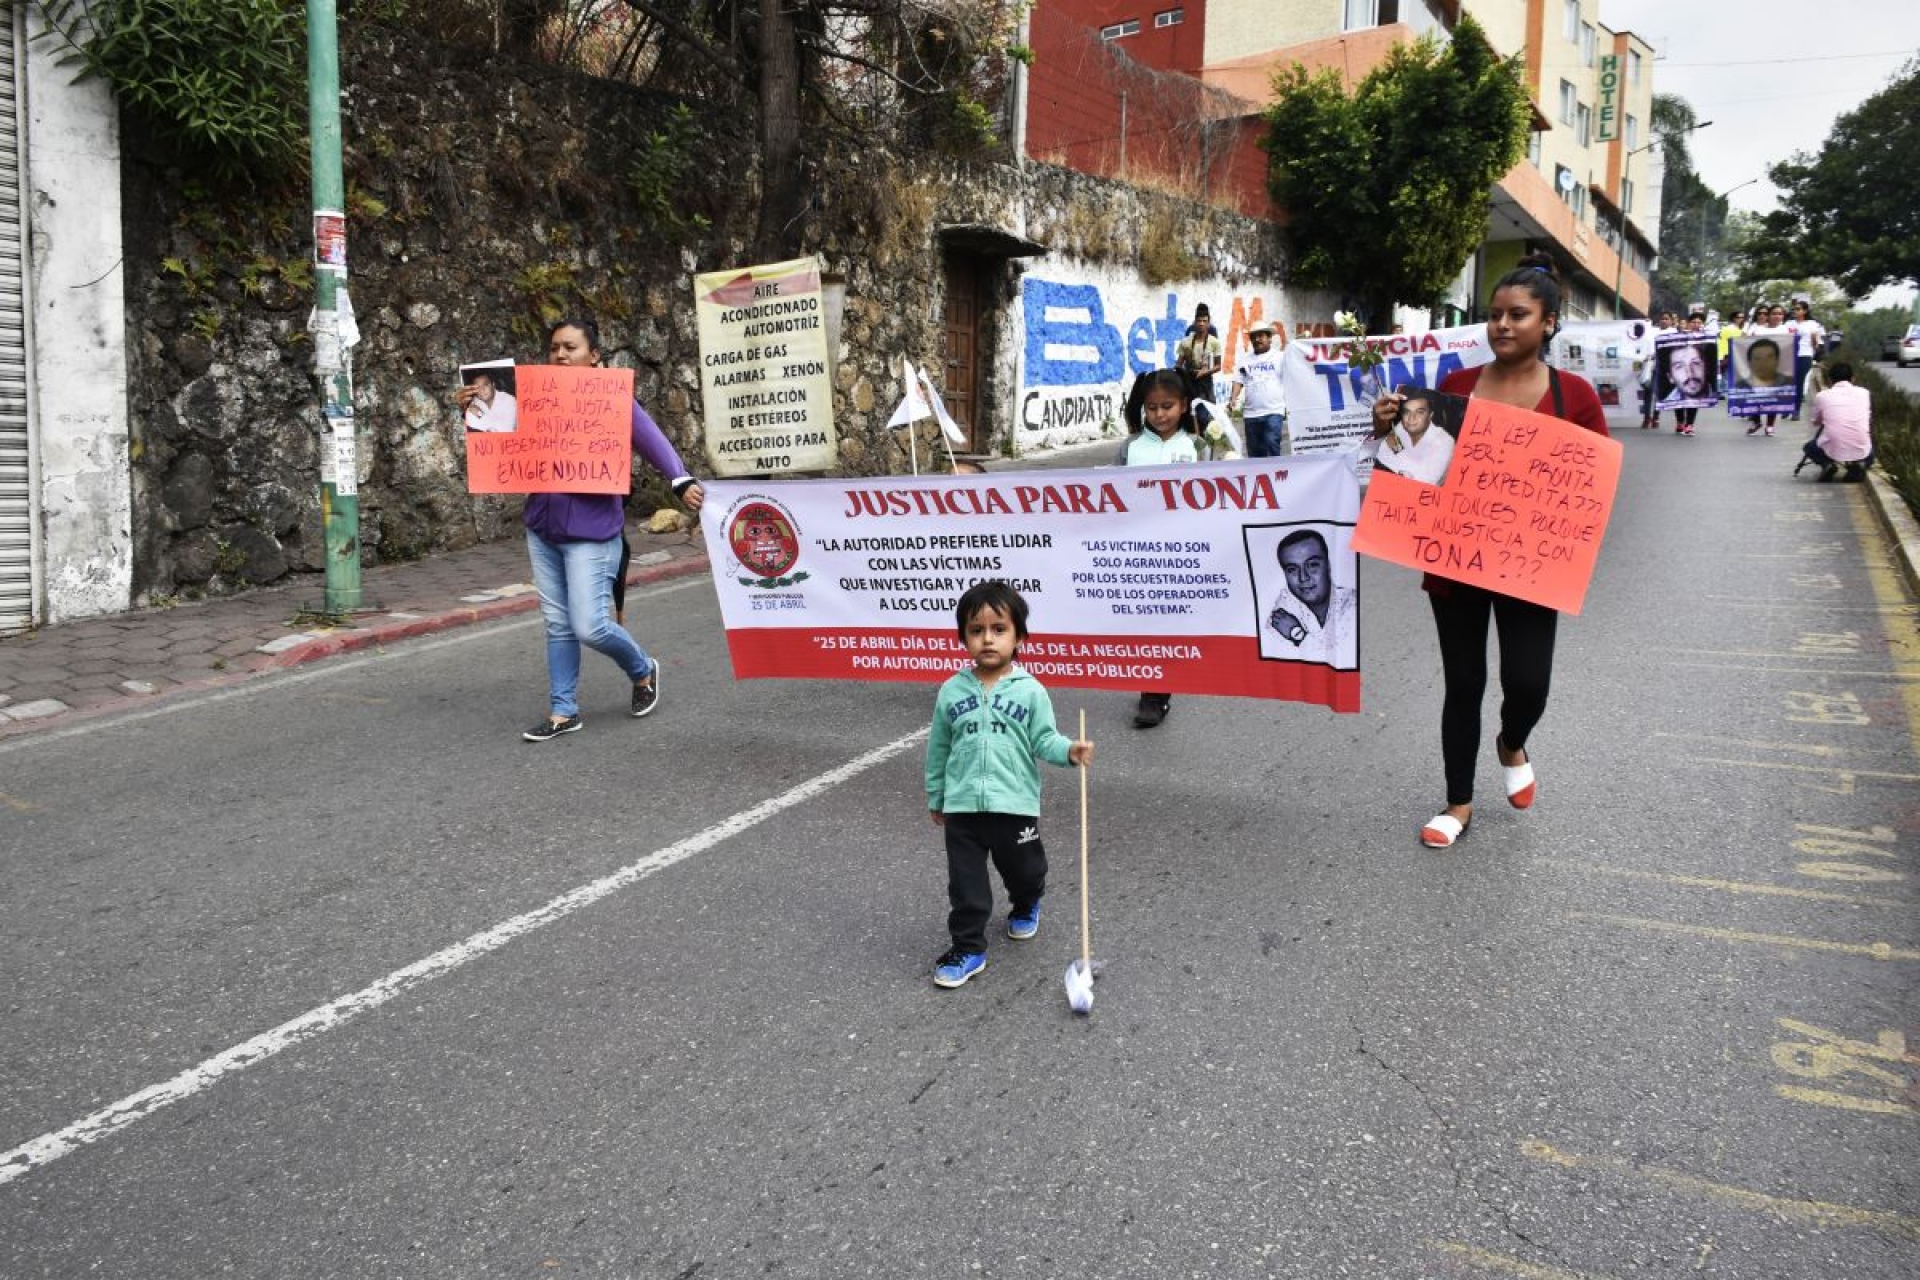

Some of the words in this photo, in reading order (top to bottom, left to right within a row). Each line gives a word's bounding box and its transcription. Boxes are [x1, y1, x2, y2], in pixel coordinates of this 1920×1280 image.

[1600, 55, 1616, 138] HOTEL
[753, 283, 780, 299] AIRE
[721, 298, 818, 324] ACONDICIONADO
[1023, 276, 1188, 388] Bet
[1447, 339, 1479, 350] PARA
[705, 354, 745, 367] CARGA
[746, 348, 761, 361] DE
[764, 344, 788, 358] GAS
[713, 367, 766, 387] ALARMAS
[782, 360, 825, 379] XENÓN
[542, 375, 558, 392] LA
[571, 375, 628, 395] JUSTICIA
[728, 386, 807, 410] INSTALACIÓN
[1023, 391, 1112, 431] CANDIDATO
[730, 416, 745, 429] DE
[474, 440, 493, 456] NO
[718, 435, 791, 454] ACCESORIOS
[794, 431, 828, 447] PARA
[1470, 414, 1493, 437] LA
[1503, 424, 1540, 448] LEY
[1549, 438, 1599, 468] DEBE
[756, 455, 791, 470] AUTO
[1458, 466, 1471, 487] Y
[1528, 458, 1596, 489] PRONTA
[844, 486, 1014, 519] JUSTICIA
[1013, 481, 1129, 515] PARA
[1418, 490, 1443, 507] EN
[1374, 500, 1418, 525] TANTA
[1431, 517, 1523, 547] INJUSTICIA
[1537, 540, 1575, 563] CON
[843, 536, 926, 551] AUTORIDAD
[930, 534, 999, 549] PREFIERE
[1001, 533, 1052, 548] LIDIAR
[1108, 541, 1162, 553] VICTIMAS
[1164, 541, 1183, 552] NO
[1185, 541, 1210, 553] SON
[868, 557, 899, 571] CON
[900, 557, 928, 571] LAS
[930, 555, 1002, 570] VÍCTIMAS
[1092, 557, 1122, 568] SOLO
[1124, 557, 1201, 569] AGRAVIADOS
[1412, 535, 1484, 571] TONA
[839, 577, 868, 592] QUE
[869, 577, 954, 592] INVESTIGAR
[956, 577, 966, 591] Y
[969, 577, 1042, 593] CIGAR
[1072, 572, 1096, 583] POR
[1096, 572, 1118, 583] LOS
[1076, 588, 1087, 599] SI
[1088, 588, 1105, 600] NO
[1106, 588, 1122, 600] DE
[1123, 588, 1146, 600] LOS
[1147, 588, 1230, 600] OPERADORES
[766, 600, 778, 610] DE
[780, 599, 807, 610] ABRIL
[879, 598, 890, 612] A
[892, 598, 918, 612] LOS
[920, 598, 958, 612] CULP
[1111, 603, 1134, 615] DEL
[838, 637, 858, 650] DE
[860, 636, 899, 650] ABRIL
[901, 634, 926, 651] DÍA
[928, 638, 946, 651] DE
[949, 638, 969, 652] LA
[1017, 642, 1046, 656] MAS
[1047, 643, 1068, 657] DE
[1070, 644, 1092, 657] LA
[1093, 645, 1202, 660] NEGLIGENCIA
[852, 655, 880, 669] POR
[1010, 660, 1084, 675] RVIDORES
[1087, 660, 1164, 680] PÚBLICOS
